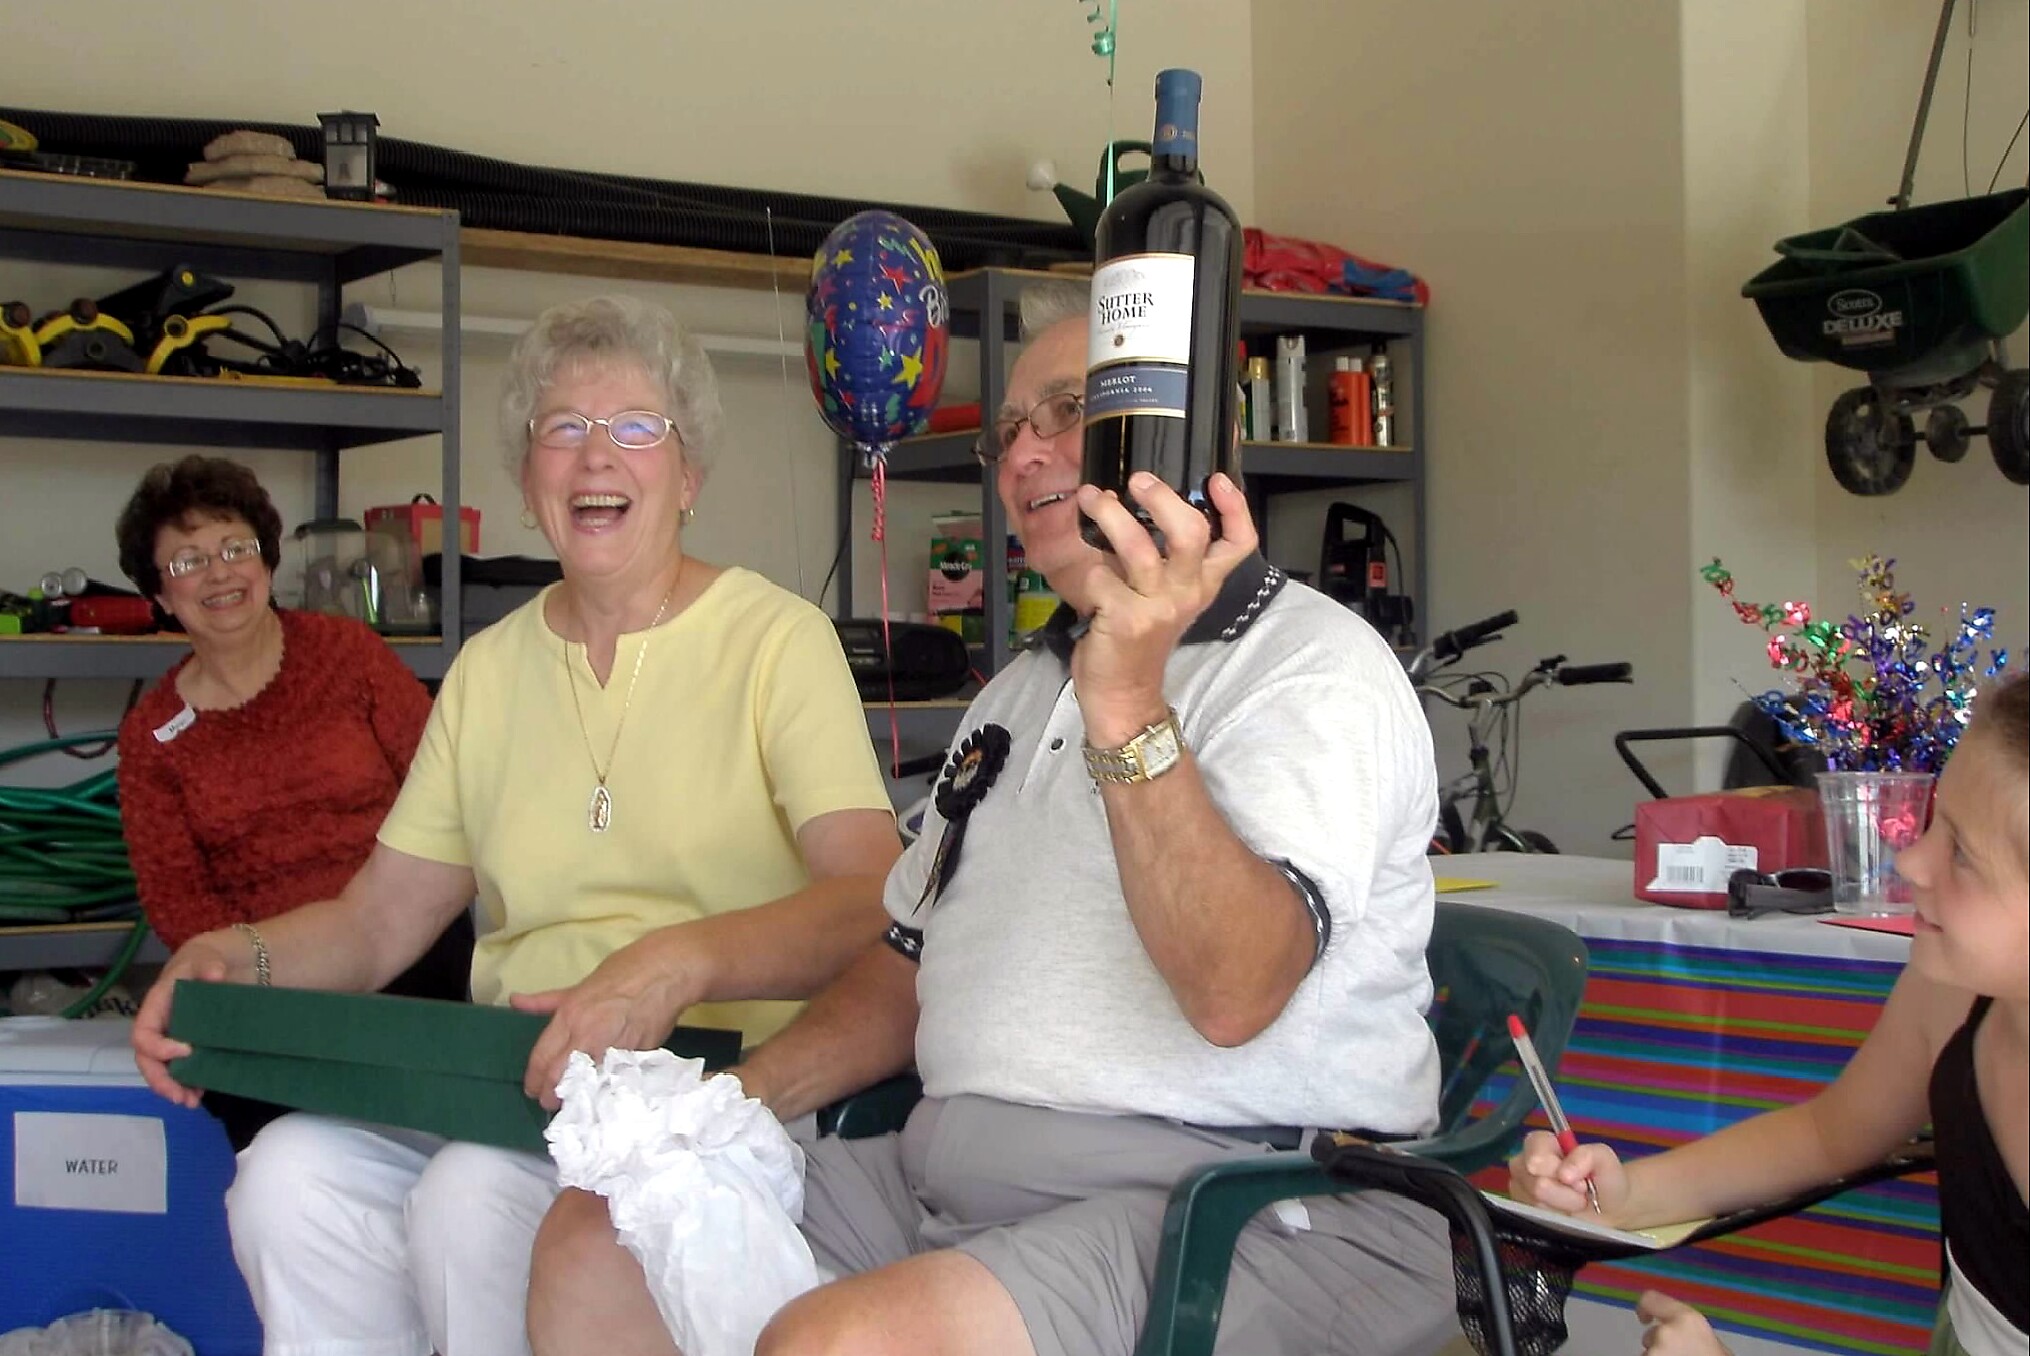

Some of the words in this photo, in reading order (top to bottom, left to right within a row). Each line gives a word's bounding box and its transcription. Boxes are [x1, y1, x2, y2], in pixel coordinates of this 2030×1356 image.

[1097, 292, 1154, 311] SUTTER
[1101, 306, 1147, 325] HOME
[1823, 311, 1902, 334] DELUXE
[1100, 375, 1137, 387] MERLOT
[65, 1159, 118, 1174] WATER
